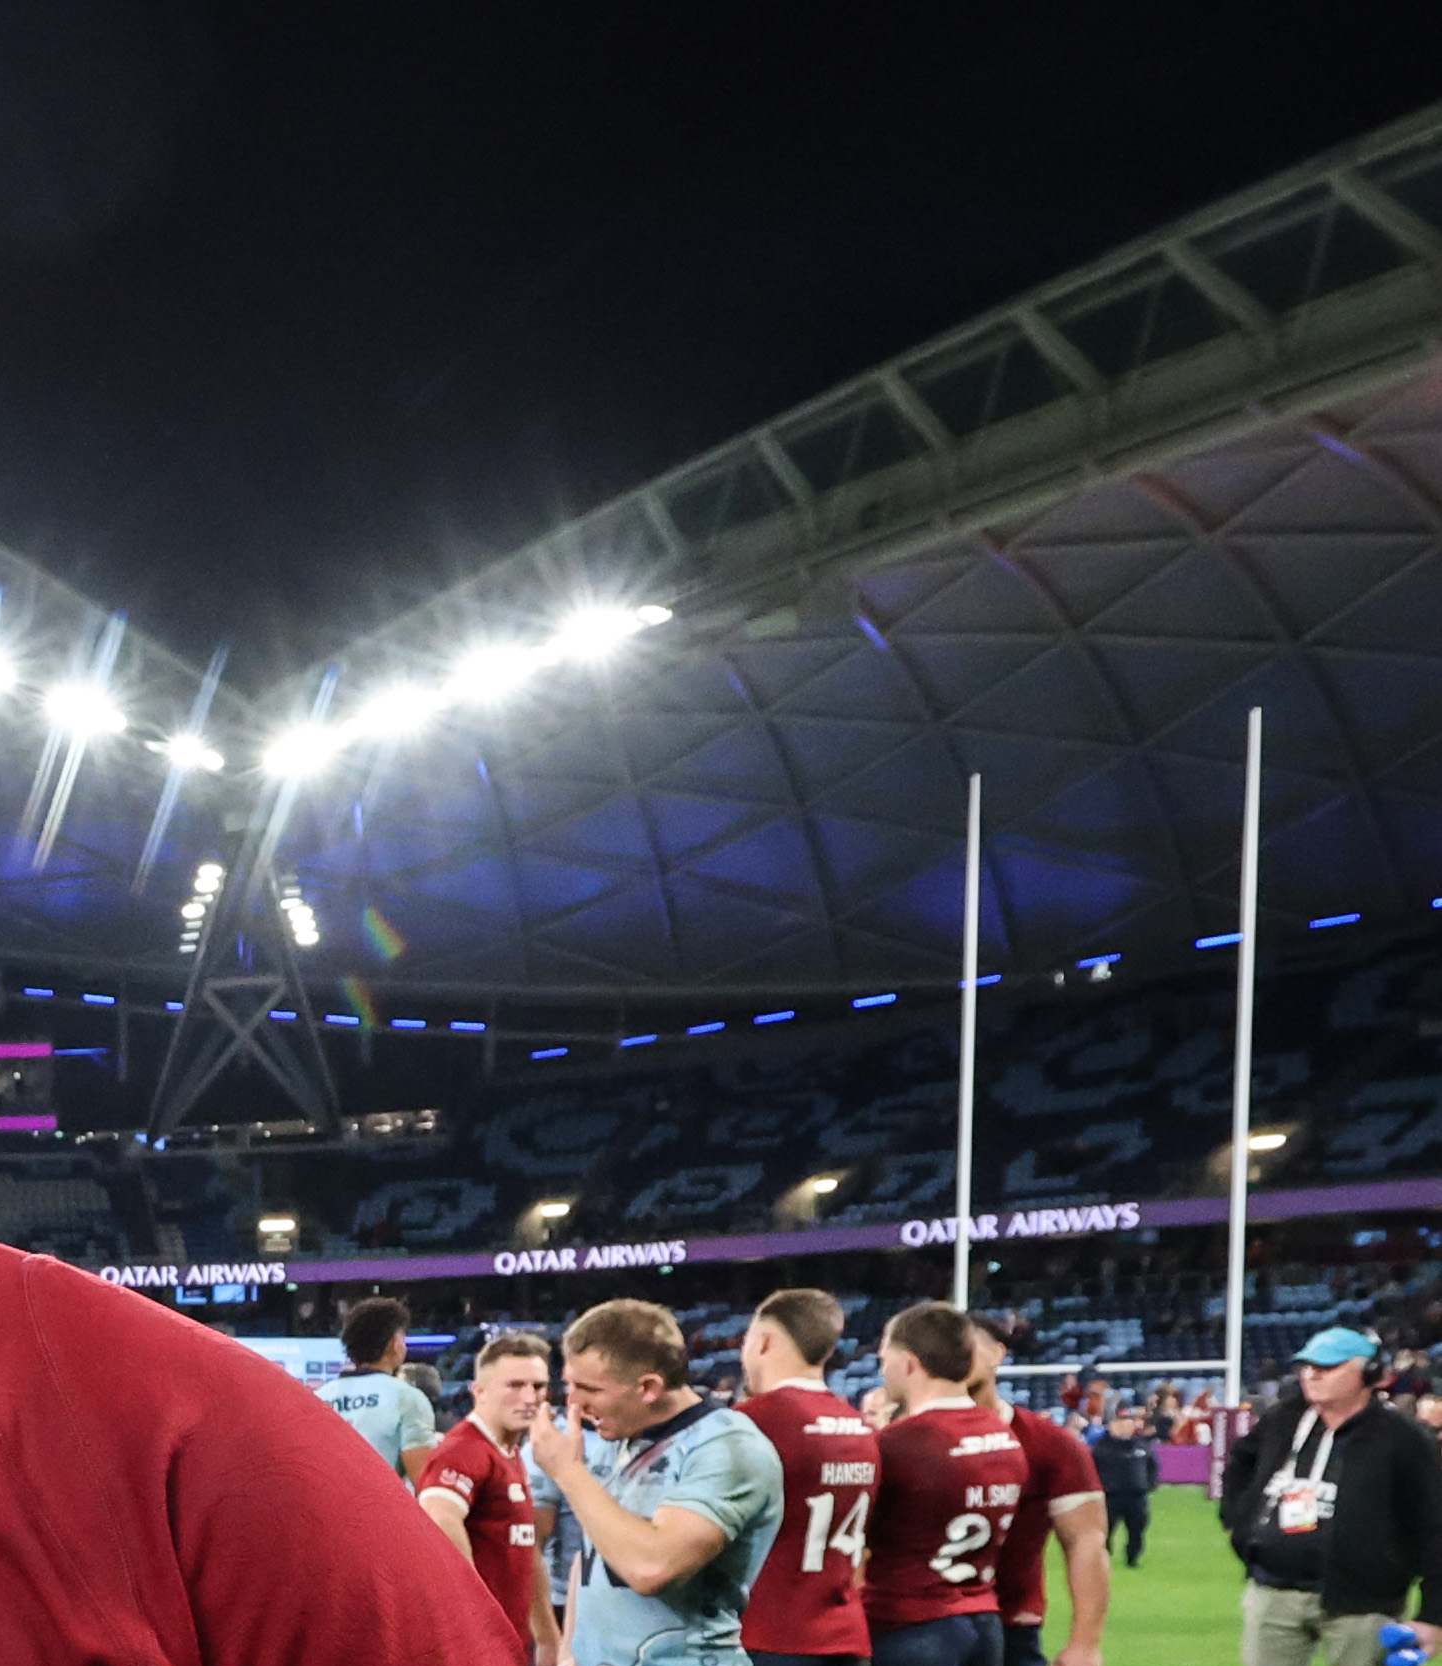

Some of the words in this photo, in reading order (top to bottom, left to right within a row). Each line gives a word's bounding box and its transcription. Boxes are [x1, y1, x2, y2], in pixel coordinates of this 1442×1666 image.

[900, 1214, 999, 1247] QATAR
[1006, 1202, 1141, 1238] AIRWAYS
[100, 1265, 178, 1287] QATAR
[185, 1262, 287, 1286] AIRWAYS
[493, 1248, 577, 1276] QATAR
[583, 1240, 687, 1270] AIRWAYS
[801, 1490, 871, 1574] 14
